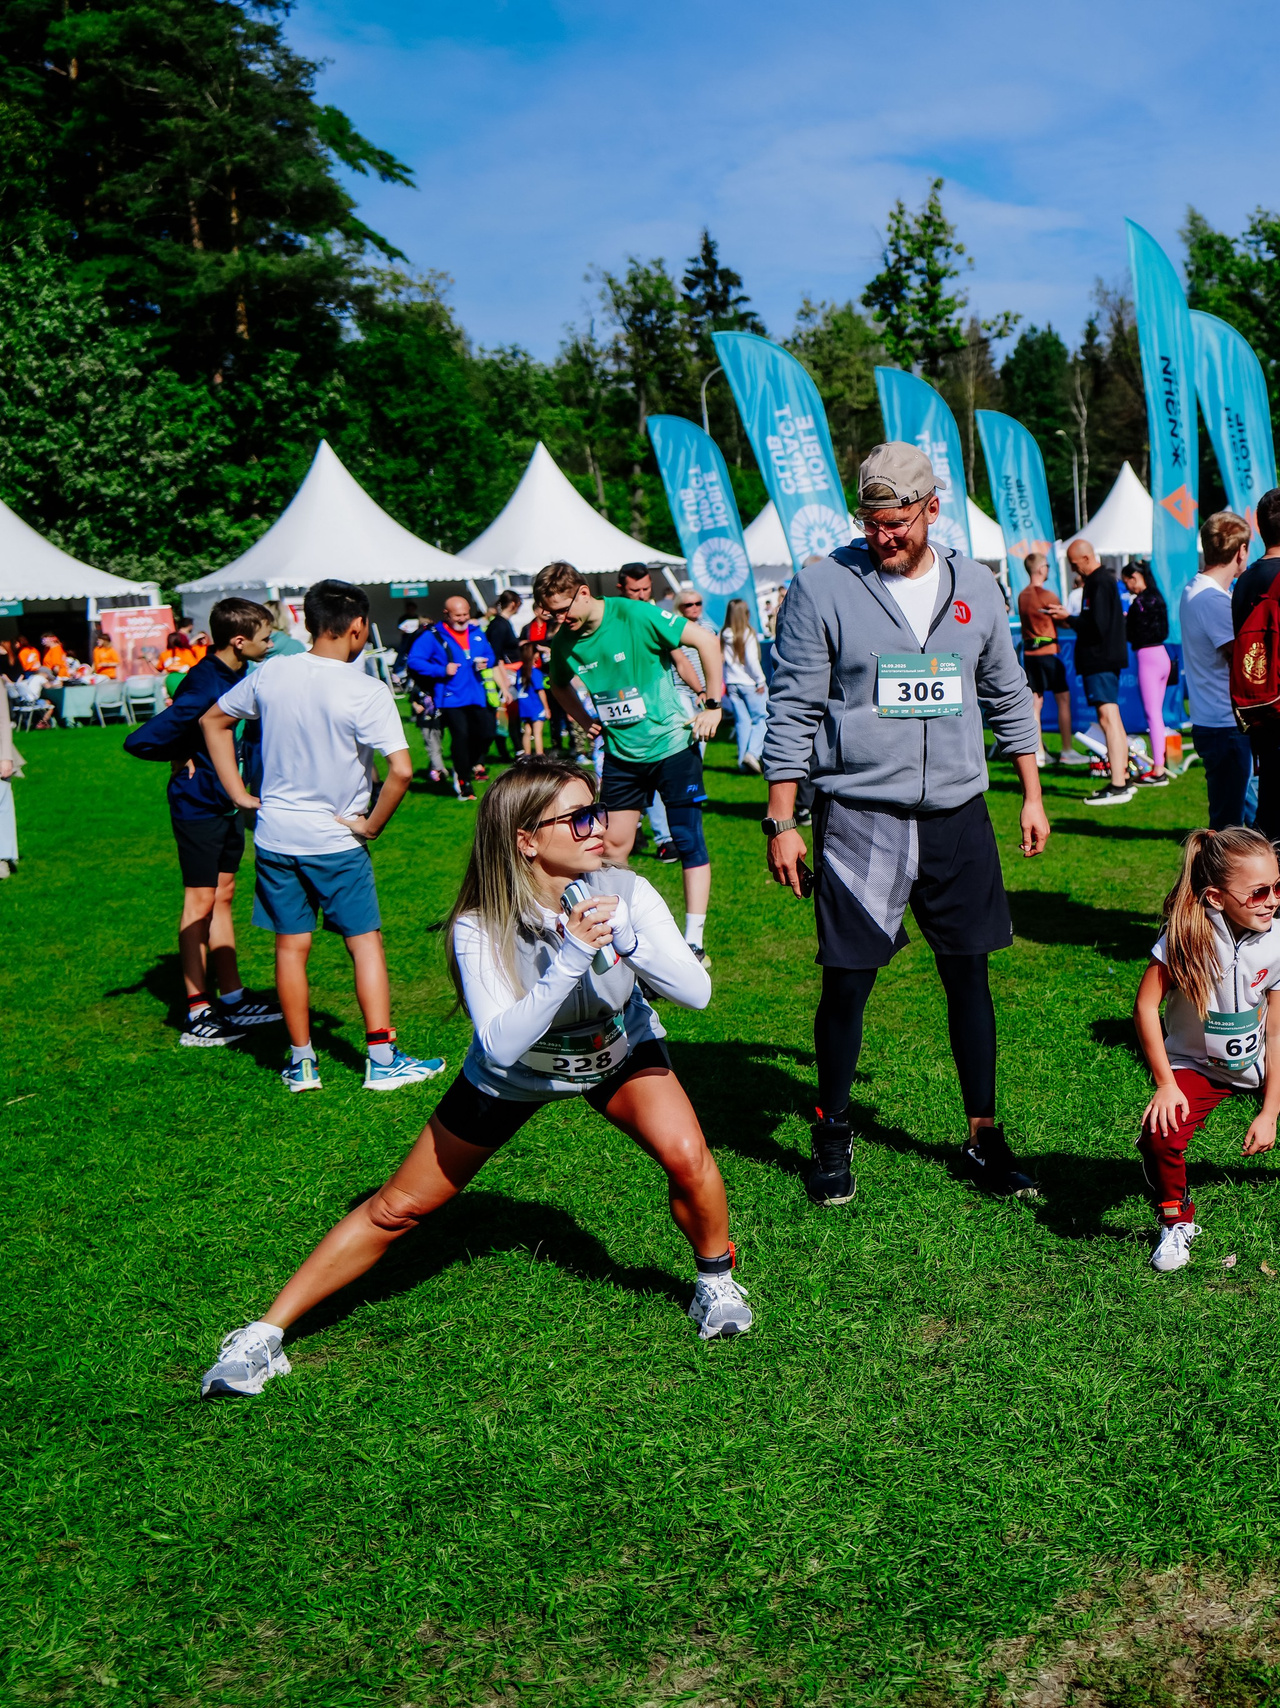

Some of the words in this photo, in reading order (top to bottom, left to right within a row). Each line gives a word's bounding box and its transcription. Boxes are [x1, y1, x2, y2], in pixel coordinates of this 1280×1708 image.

[898, 681, 945, 702] 306
[607, 703, 632, 718] 314
[1226, 1033, 1258, 1057] 62
[552, 1051, 612, 1073] 228
